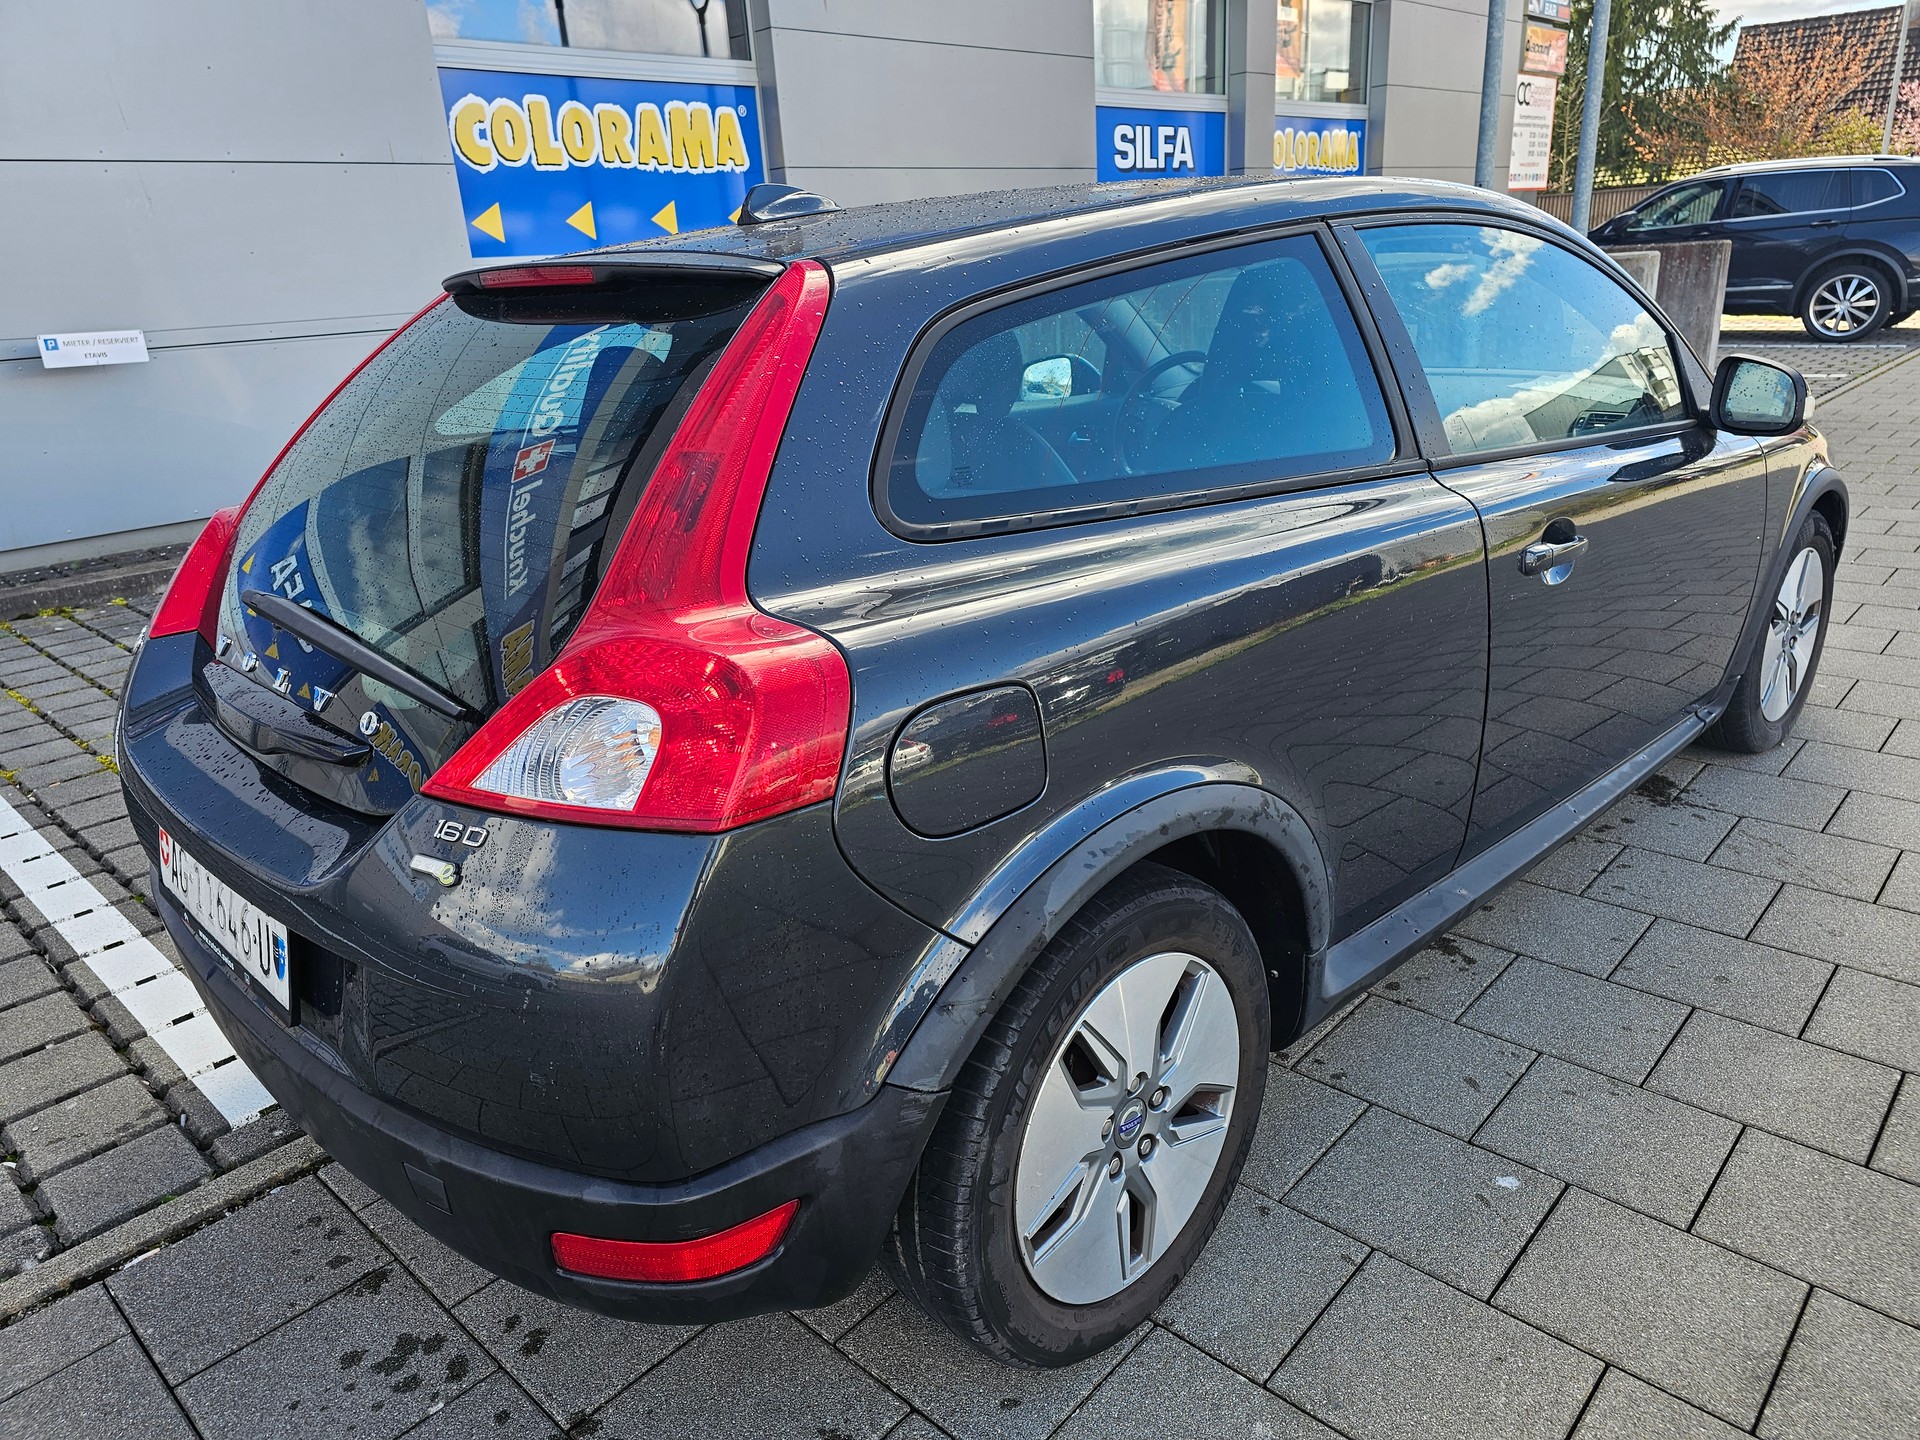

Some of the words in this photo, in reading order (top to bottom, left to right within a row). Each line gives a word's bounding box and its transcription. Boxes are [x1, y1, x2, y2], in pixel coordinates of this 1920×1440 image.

[449, 93, 750, 173] COLORAMA
[1113, 124, 1195, 170] SILFA
[1273, 127, 1359, 172] OLORAMA
[84, 351, 108, 359] ETAVIS
[97, 336, 139, 346] RESERVIERT
[218, 634, 384, 736] VOLVO
[1120, 1116, 1142, 1131] VOLVO
